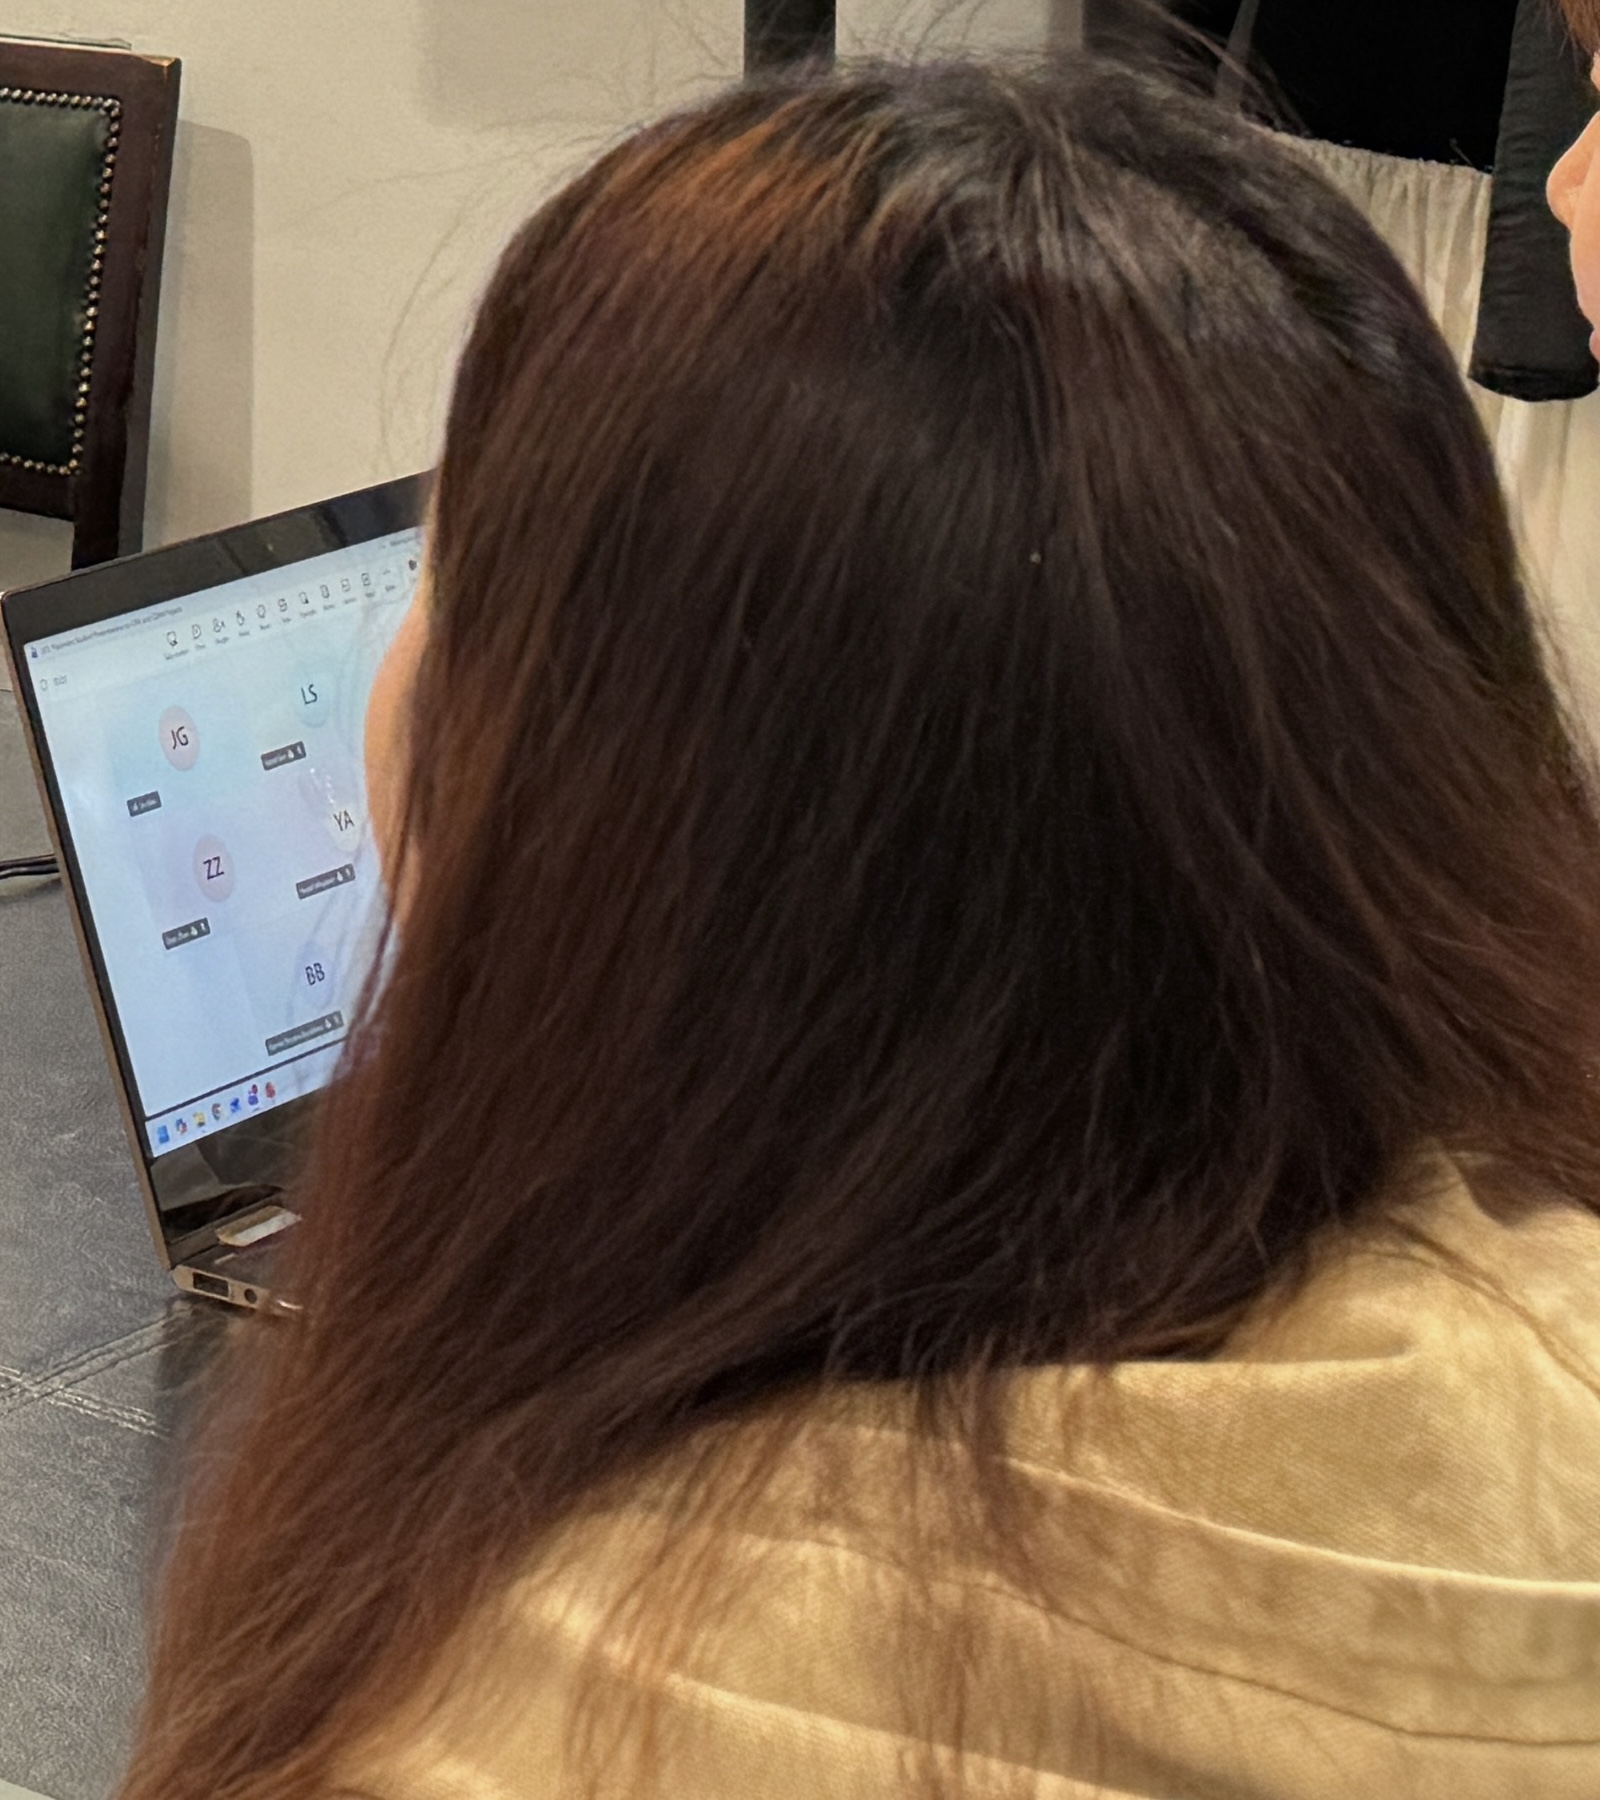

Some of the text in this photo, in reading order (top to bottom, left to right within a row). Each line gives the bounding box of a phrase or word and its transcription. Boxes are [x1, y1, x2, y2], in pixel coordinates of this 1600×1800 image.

[301, 683, 318, 705] LS
[171, 726, 189, 750] JG
[333, 810, 355, 832] YA
[203, 856, 225, 880] ZZ
[305, 962, 325, 986] BB
